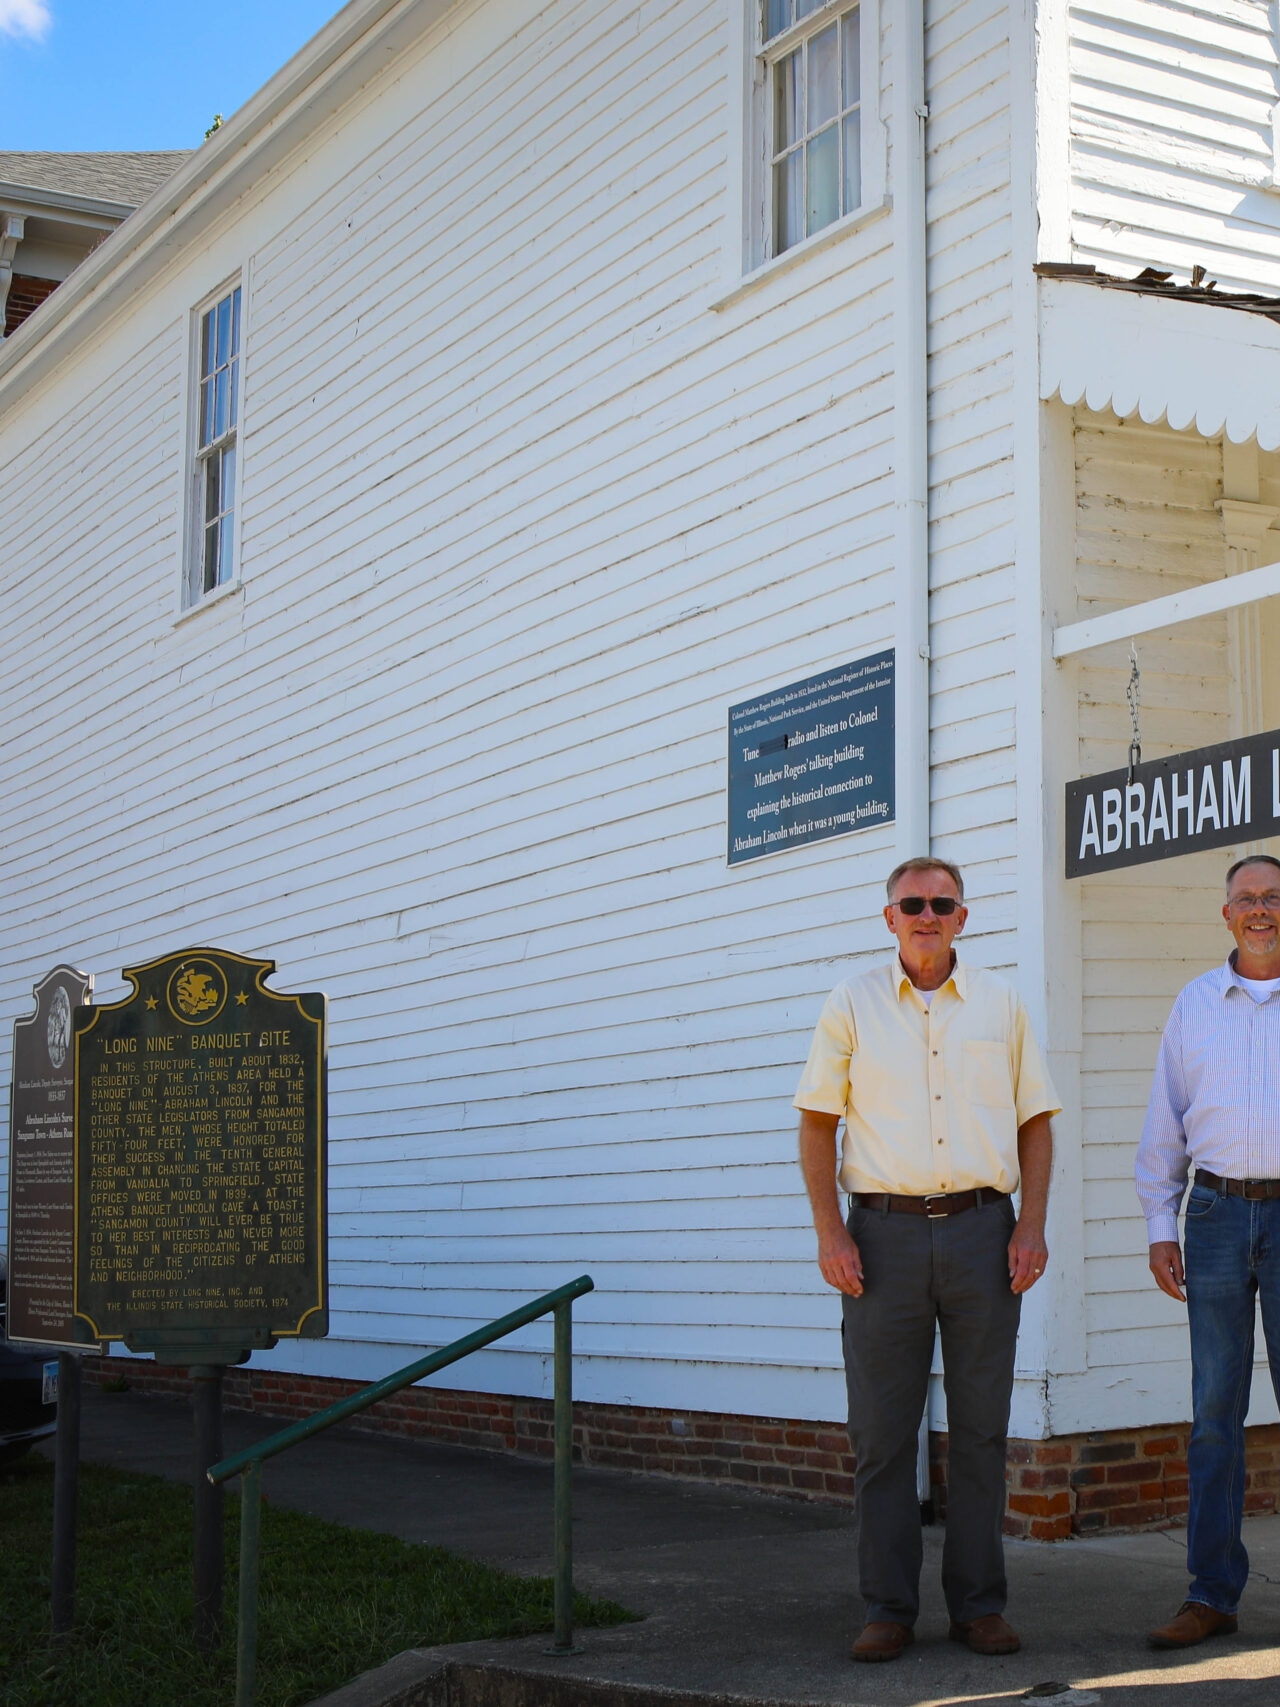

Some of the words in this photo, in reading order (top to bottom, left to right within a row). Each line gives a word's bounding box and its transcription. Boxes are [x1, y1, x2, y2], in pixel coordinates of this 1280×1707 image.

[743, 748, 760, 762] Tune
[787, 731, 805, 748] radio
[806, 725, 819, 742] and
[820, 722, 839, 738] listen
[840, 720, 848, 731] to
[848, 706, 879, 728] Colonel
[754, 769, 783, 788] Matthew
[809, 754, 834, 771] talking
[834, 744, 865, 764] building
[747, 800, 780, 822] explaining
[780, 795, 791, 809] the
[791, 784, 824, 806] historical
[824, 777, 864, 797] connection
[865, 774, 873, 786] to
[1079, 755, 1252, 861] ABRAHAM
[733, 834, 762, 852] Abraham
[763, 825, 788, 844] Lincoln
[789, 818, 807, 837] when
[808, 819, 814, 832] it
[814, 816, 828, 828] was
[828, 816, 833, 827] a
[832, 811, 856, 830] young
[856, 799, 890, 819] building.
[191, 1032, 251, 1051] BANQUET
[260, 1030, 291, 1048] SITE
[100, 1063, 110, 1074] IN
[116, 1061, 136, 1073] THIS
[208, 1057, 234, 1069] BUILT
[241, 1055, 272, 1068] ABOUT
[91, 1074, 141, 1087] RESIDENTS
[146, 1074, 159, 1085] OF
[167, 1072, 185, 1084] THE
[192, 1070, 229, 1083] ATHENS
[236, 1069, 262, 1081] AREA
[268, 1068, 292, 1079] HELD
[297, 1067, 305, 1078] A
[91, 1087, 133, 1100] BANQUET
[141, 1086, 155, 1098] ON
[163, 1084, 199, 1097] AUGUST
[258, 1081, 277, 1093] FOR
[287, 1080, 304, 1092] THE
[215, 1095, 253, 1108] LINCOLN
[260, 1094, 279, 1106] AND
[287, 1093, 304, 1105] THE
[90, 1114, 120, 1126] OTHER
[125, 1113, 153, 1125] STATE
[159, 1110, 219, 1124] LEGISLATORS
[225, 1109, 251, 1121] FROM
[256, 1106, 305, 1119] SANGAMON
[138, 1125, 156, 1137] THE
[191, 1123, 221, 1135] WHOSE
[227, 1121, 259, 1134] HEIGHT
[264, 1120, 305, 1132] TOTALED
[91, 1139, 149, 1152] FIFTY-FOUR
[196, 1136, 222, 1148] WERE
[233, 1134, 276, 1146] HONORED
[285, 1133, 305, 1144] FOR
[91, 1153, 117, 1165] THEIR
[125, 1151, 166, 1163] SUCCESS
[174, 1151, 185, 1162] IN
[194, 1150, 212, 1161] THE
[221, 1148, 253, 1160] TENTH
[262, 1146, 305, 1159] GENERAL
[91, 1165, 136, 1178] ASSEMBLY
[142, 1165, 153, 1176] IN
[157, 1163, 201, 1175] CHANGING
[207, 1162, 225, 1174] THE
[232, 1161, 261, 1173] STATE
[268, 1159, 304, 1171] CAPITAL
[90, 1179, 117, 1191] FROM
[126, 1177, 171, 1190] VANDALIA
[181, 1177, 193, 1188] TO
[274, 1173, 305, 1185] STATE
[90, 1192, 129, 1205] OFFICES
[135, 1191, 162, 1203] WERE
[170, 1190, 201, 1202] MOVED
[208, 1189, 219, 1200] IN
[265, 1187, 278, 1199] AT
[287, 1186, 305, 1198] THE
[91, 1205, 125, 1218] ATHENS
[130, 1204, 172, 1216] BANQUET
[178, 1202, 215, 1215] LINCOLN
[221, 1201, 245, 1213] GAVE
[252, 1201, 260, 1212] A
[154, 1216, 191, 1228] COUNTY
[199, 1215, 220, 1227] WILL
[228, 1214, 254, 1226] EVER
[260, 1214, 273, 1225] BE
[279, 1213, 304, 1224] TRUE
[91, 1232, 103, 1244] TO
[109, 1231, 127, 1243] HER
[132, 1230, 156, 1242] BEST
[162, 1229, 211, 1242] INTERESTS
[217, 1228, 235, 1240] AND
[242, 1227, 274, 1239] NEVER
[279, 1226, 304, 1238] MORE
[90, 1271, 109, 1283] AND
